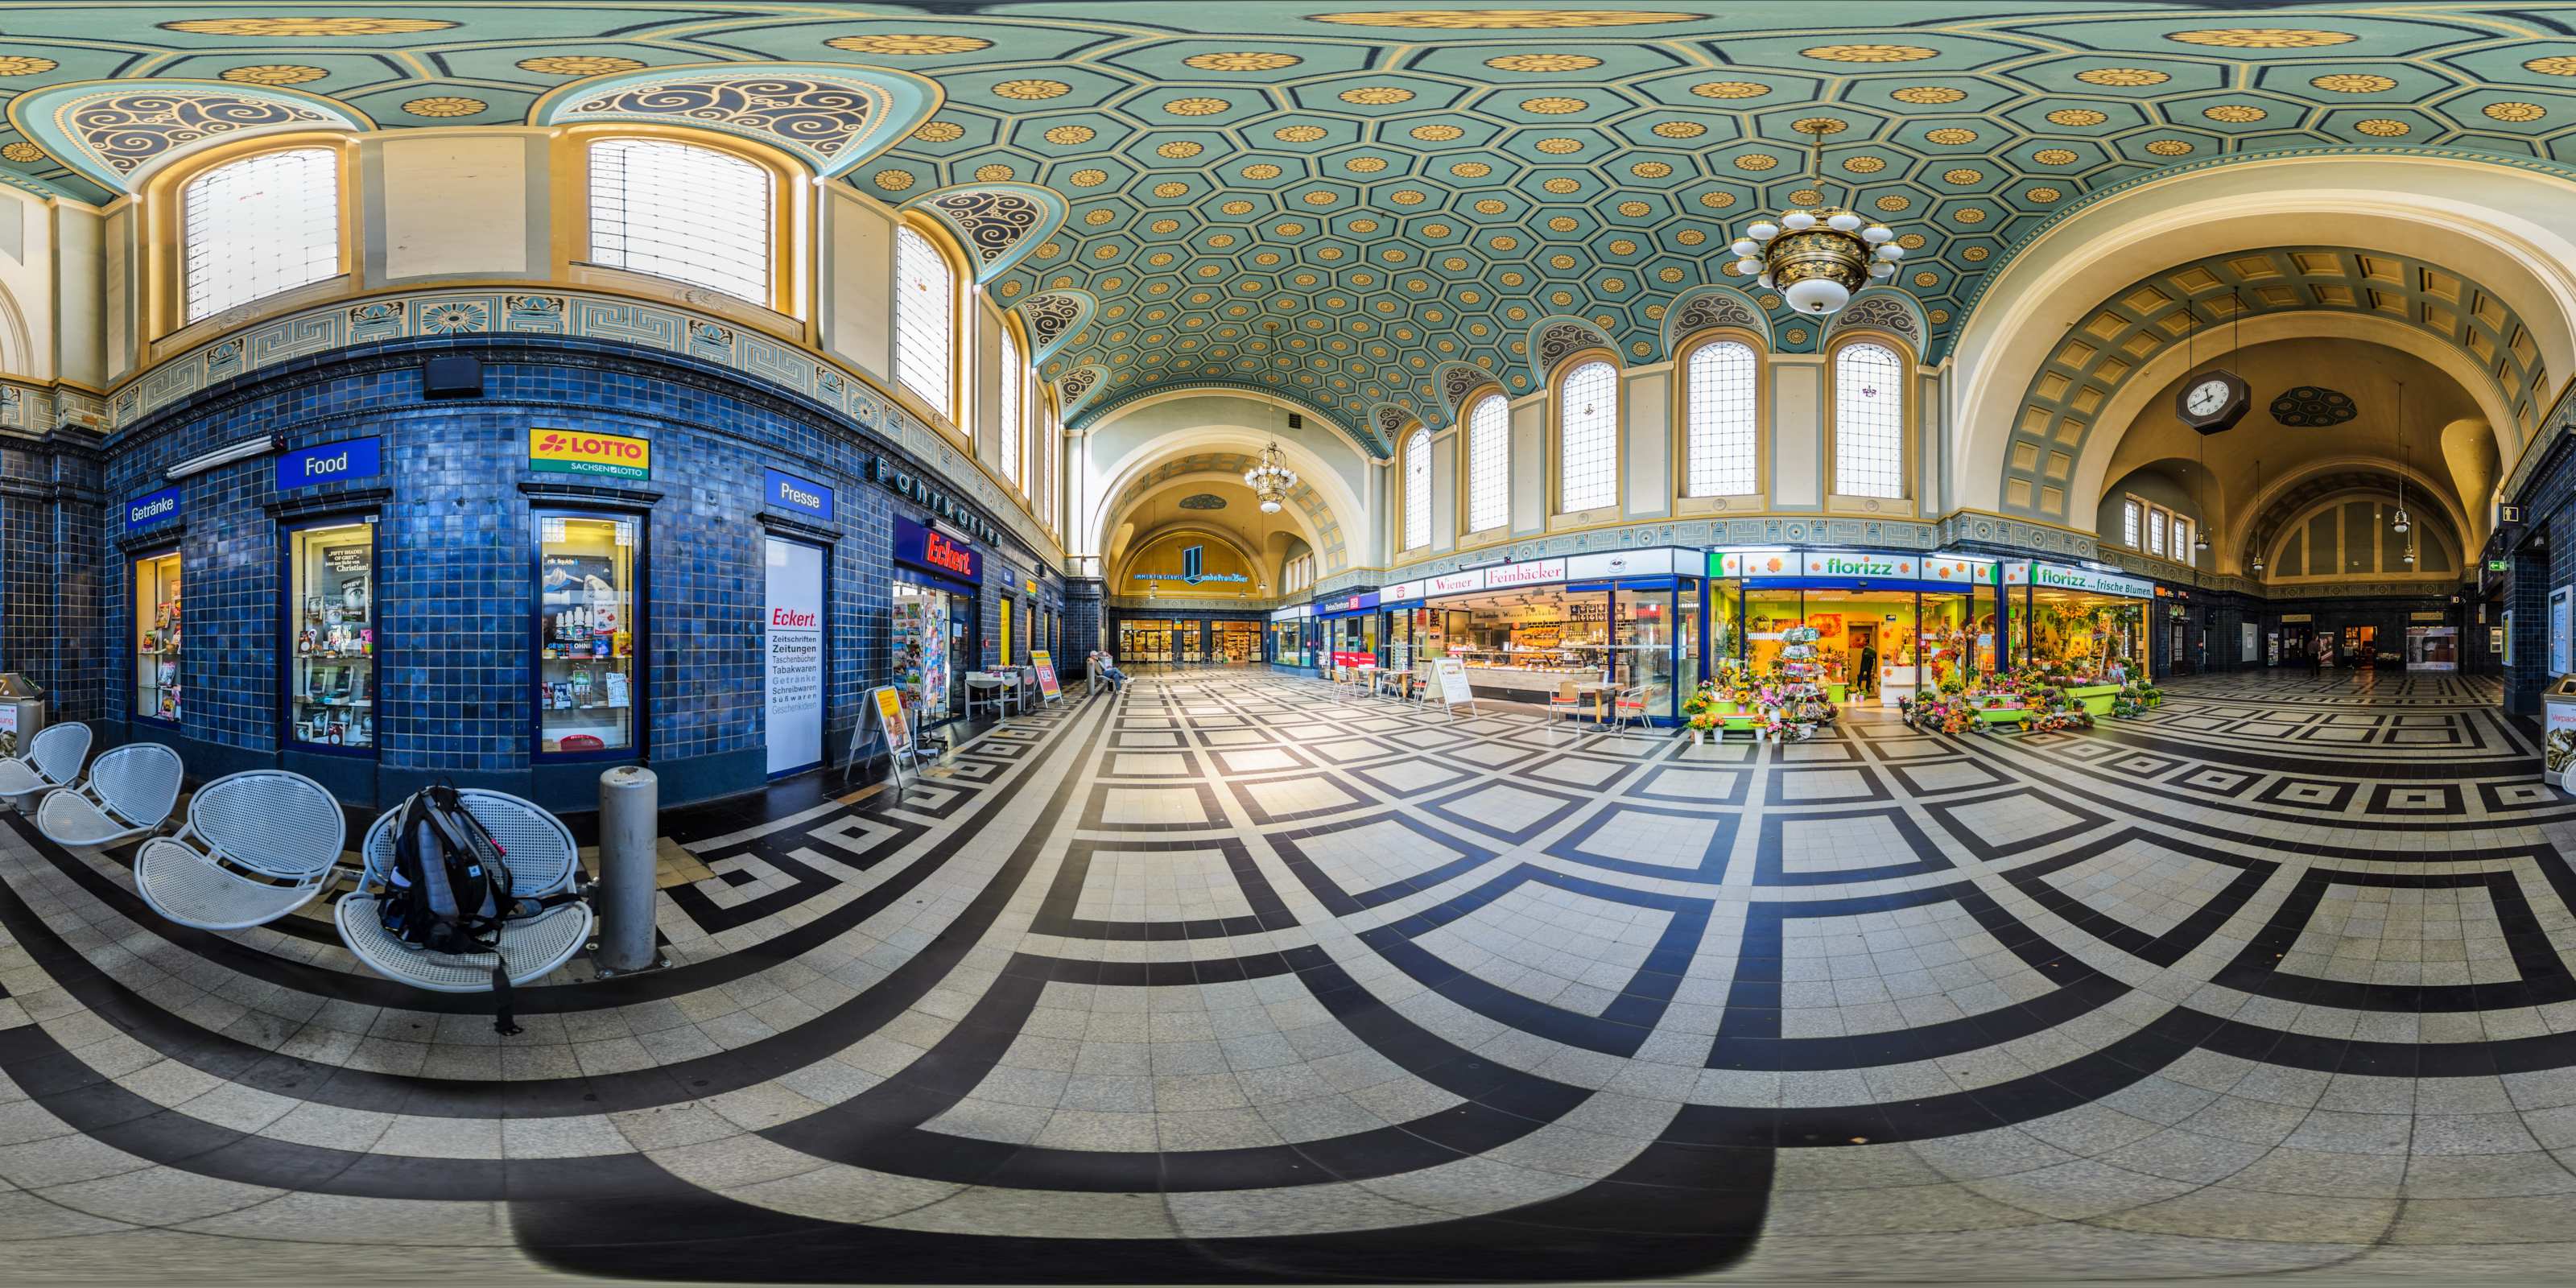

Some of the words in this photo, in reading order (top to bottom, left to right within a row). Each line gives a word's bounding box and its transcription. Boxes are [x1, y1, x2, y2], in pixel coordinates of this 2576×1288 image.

[572, 437, 642, 459] LOTTO
[305, 452, 347, 477] Food
[571, 463, 610, 473] SACHSEN
[617, 468, 642, 477] LOTTO
[781, 482, 820, 509] Presse
[874, 456, 1002, 547] Fahrkarten
[131, 497, 174, 522] Getränke
[336, 564, 369, 572] Christian!
[1827, 555, 1893, 575] florizz
[1435, 577, 1472, 592] Wiener
[1489, 563, 1562, 584] Feinbäcker
[2041, 568, 2086, 588] florizz
[2096, 579, 2124, 593] frische
[2125, 584, 2153, 597] Blumen.
[773, 608, 816, 626] Eckert.
[773, 645, 816, 654] Zeitungen
[773, 655, 816, 664] Taschenbücher
[773, 665, 816, 675] Tabakwaren
[773, 675, 816, 685] Getränke
[773, 684, 816, 695] Schreibwaren
[773, 694, 816, 703] Süßwaren
